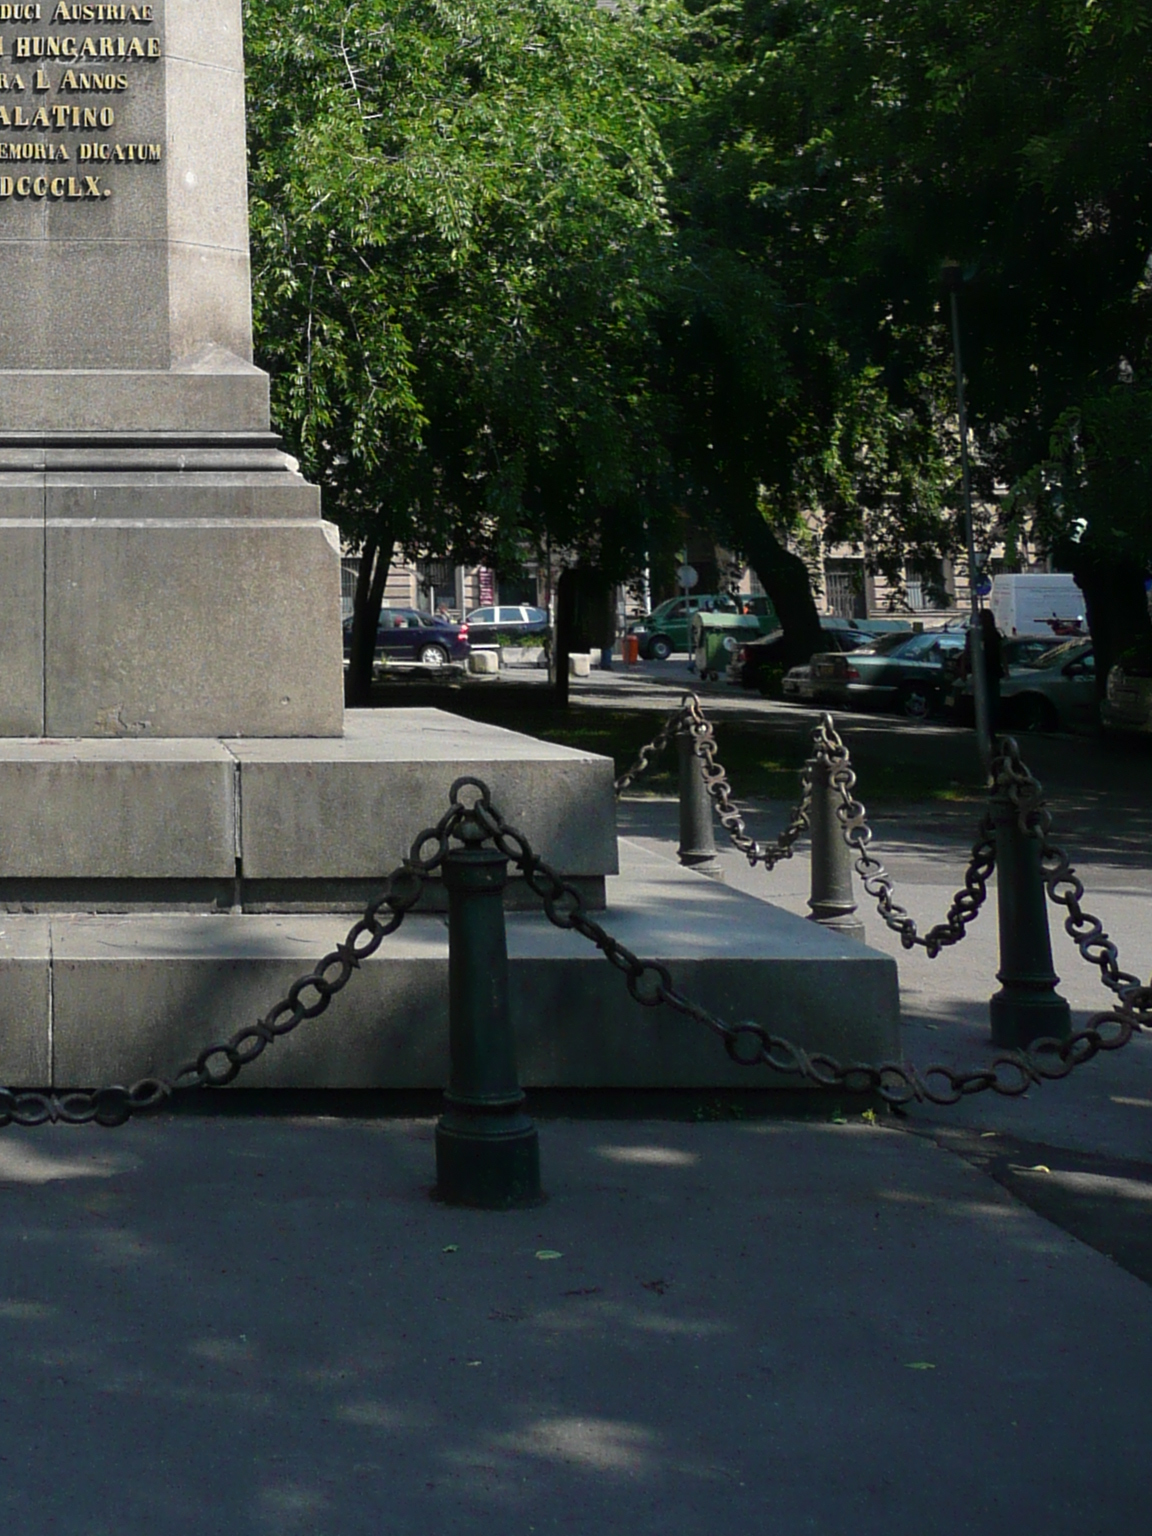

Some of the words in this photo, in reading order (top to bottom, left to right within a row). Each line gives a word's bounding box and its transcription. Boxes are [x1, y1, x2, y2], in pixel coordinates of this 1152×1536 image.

[54, 1, 153, 21] AUSTRIAE
[17, 37, 161, 57] HUNGARIAE
[36, 70, 49, 89] L
[61, 70, 128, 89] ANNOS
[80, 142, 161, 160] DICATUM
